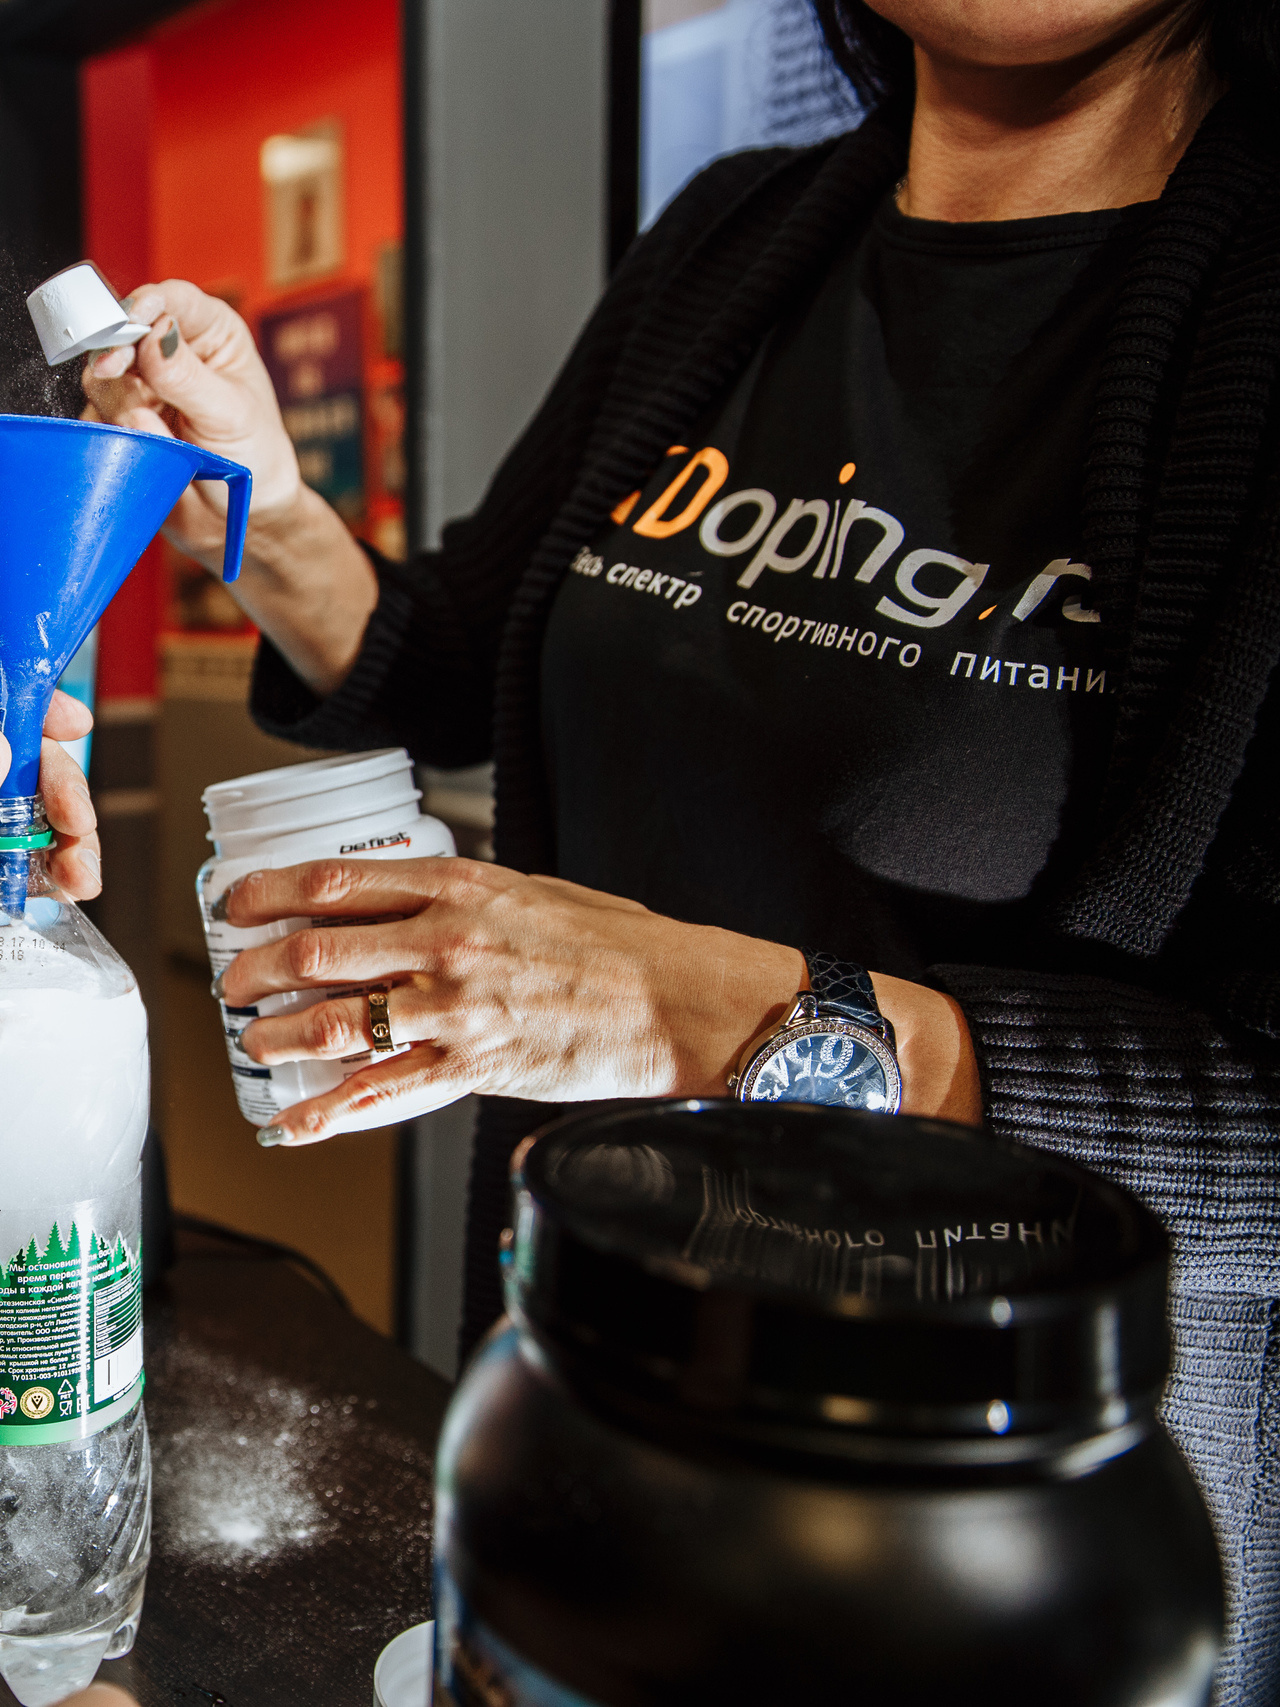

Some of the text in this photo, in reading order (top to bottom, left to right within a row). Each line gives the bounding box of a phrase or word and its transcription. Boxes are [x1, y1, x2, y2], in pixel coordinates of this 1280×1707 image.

[605, 560, 702, 610] спектр
[726, 601, 921, 668] спортивного
[950, 651, 1111, 693] питани
[9, 1264, 26, 1272] Мы
[18, 1275, 46, 1284] время
[28, 1282, 64, 1294] каждой
